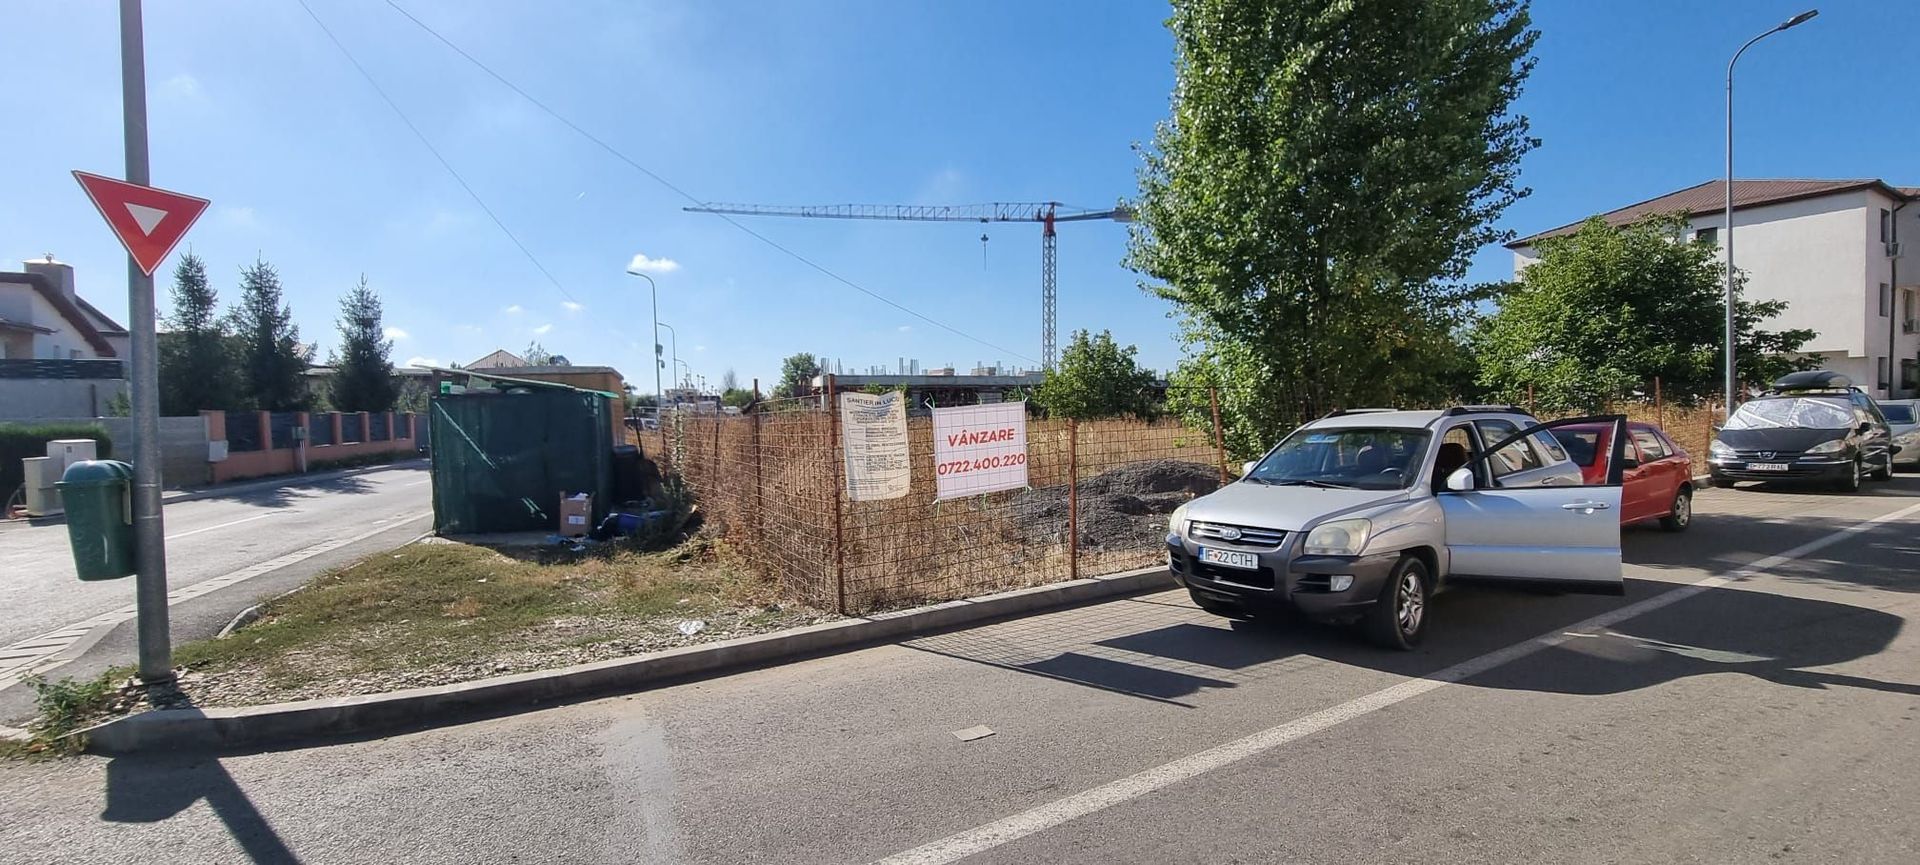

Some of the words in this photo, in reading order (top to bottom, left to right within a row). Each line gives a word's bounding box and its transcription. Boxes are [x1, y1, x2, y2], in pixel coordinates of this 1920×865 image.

[948, 428, 1015, 447] VÂNZARE
[937, 453, 1026, 476] 0722.400.220
[1217, 551, 1229, 563] 22
[1230, 553, 1253, 567] CTH
